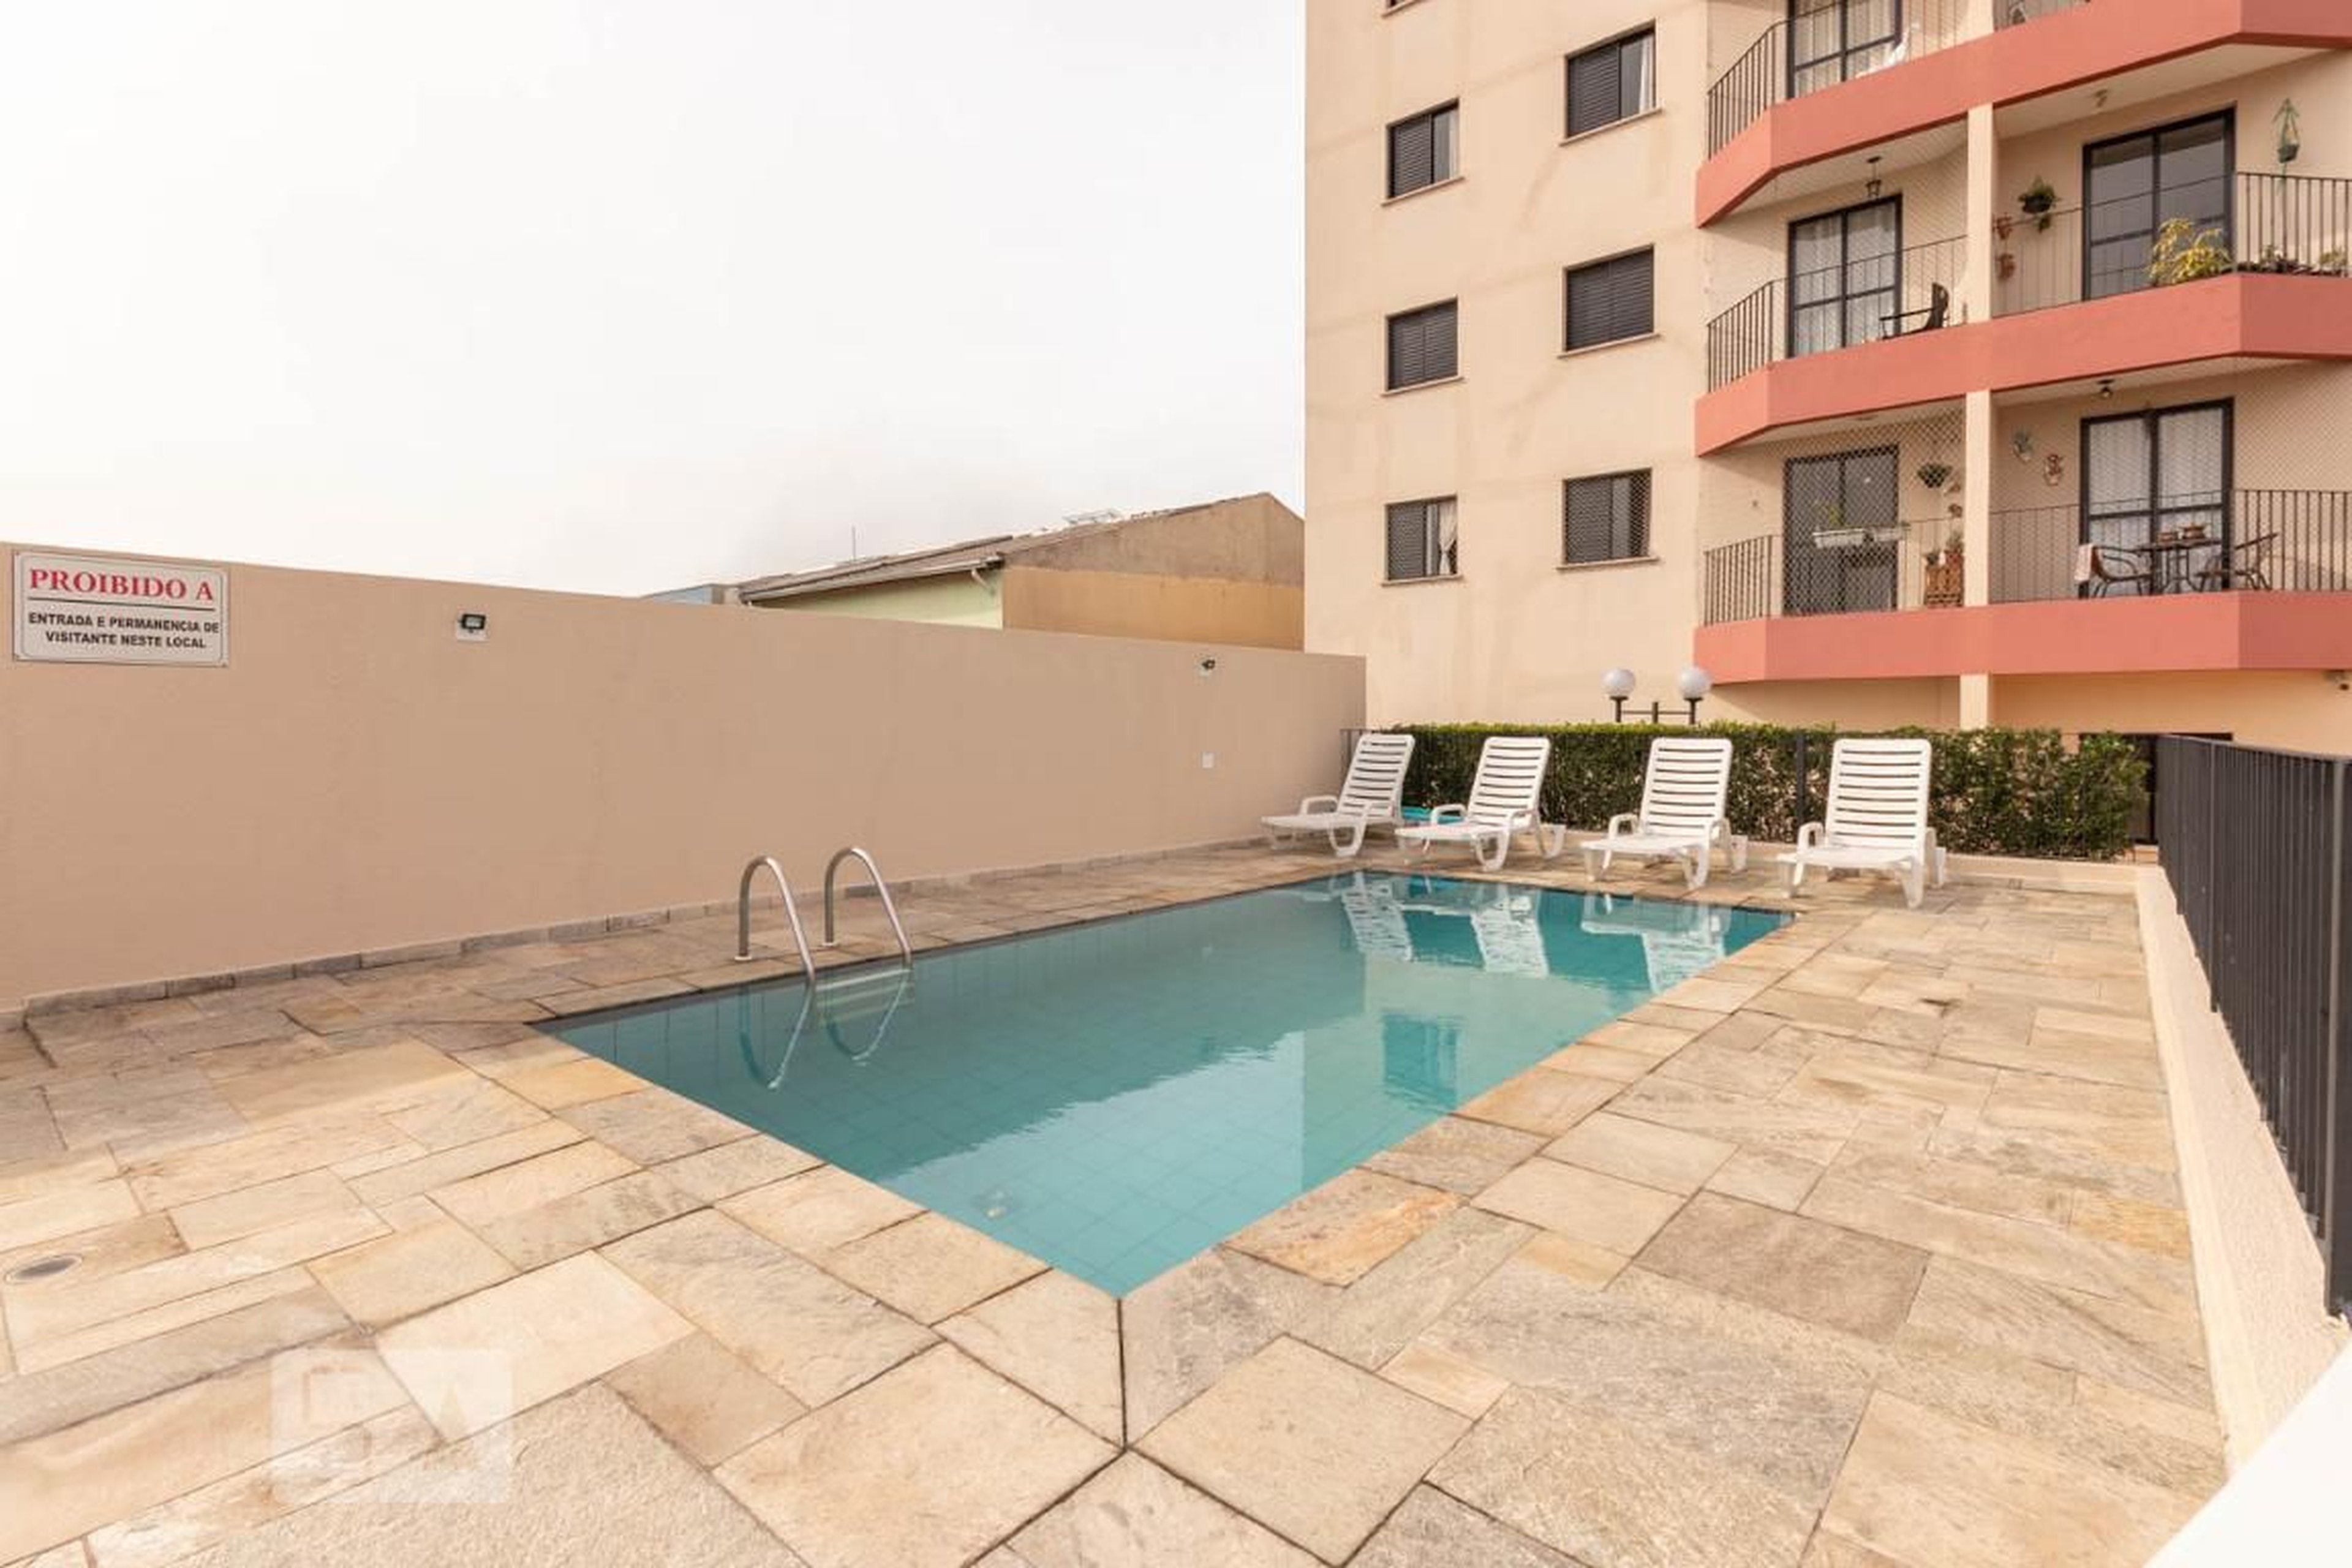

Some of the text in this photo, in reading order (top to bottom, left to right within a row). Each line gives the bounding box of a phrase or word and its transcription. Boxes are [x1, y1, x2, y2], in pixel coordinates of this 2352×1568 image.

[29, 568, 213, 601] PROIBIDO A
[29, 612, 92, 625] ENTRADA
[97, 616, 105, 627] E
[203, 622, 219, 633] DE
[46, 631, 206, 648] VISITANTE NESTE LOCAL
